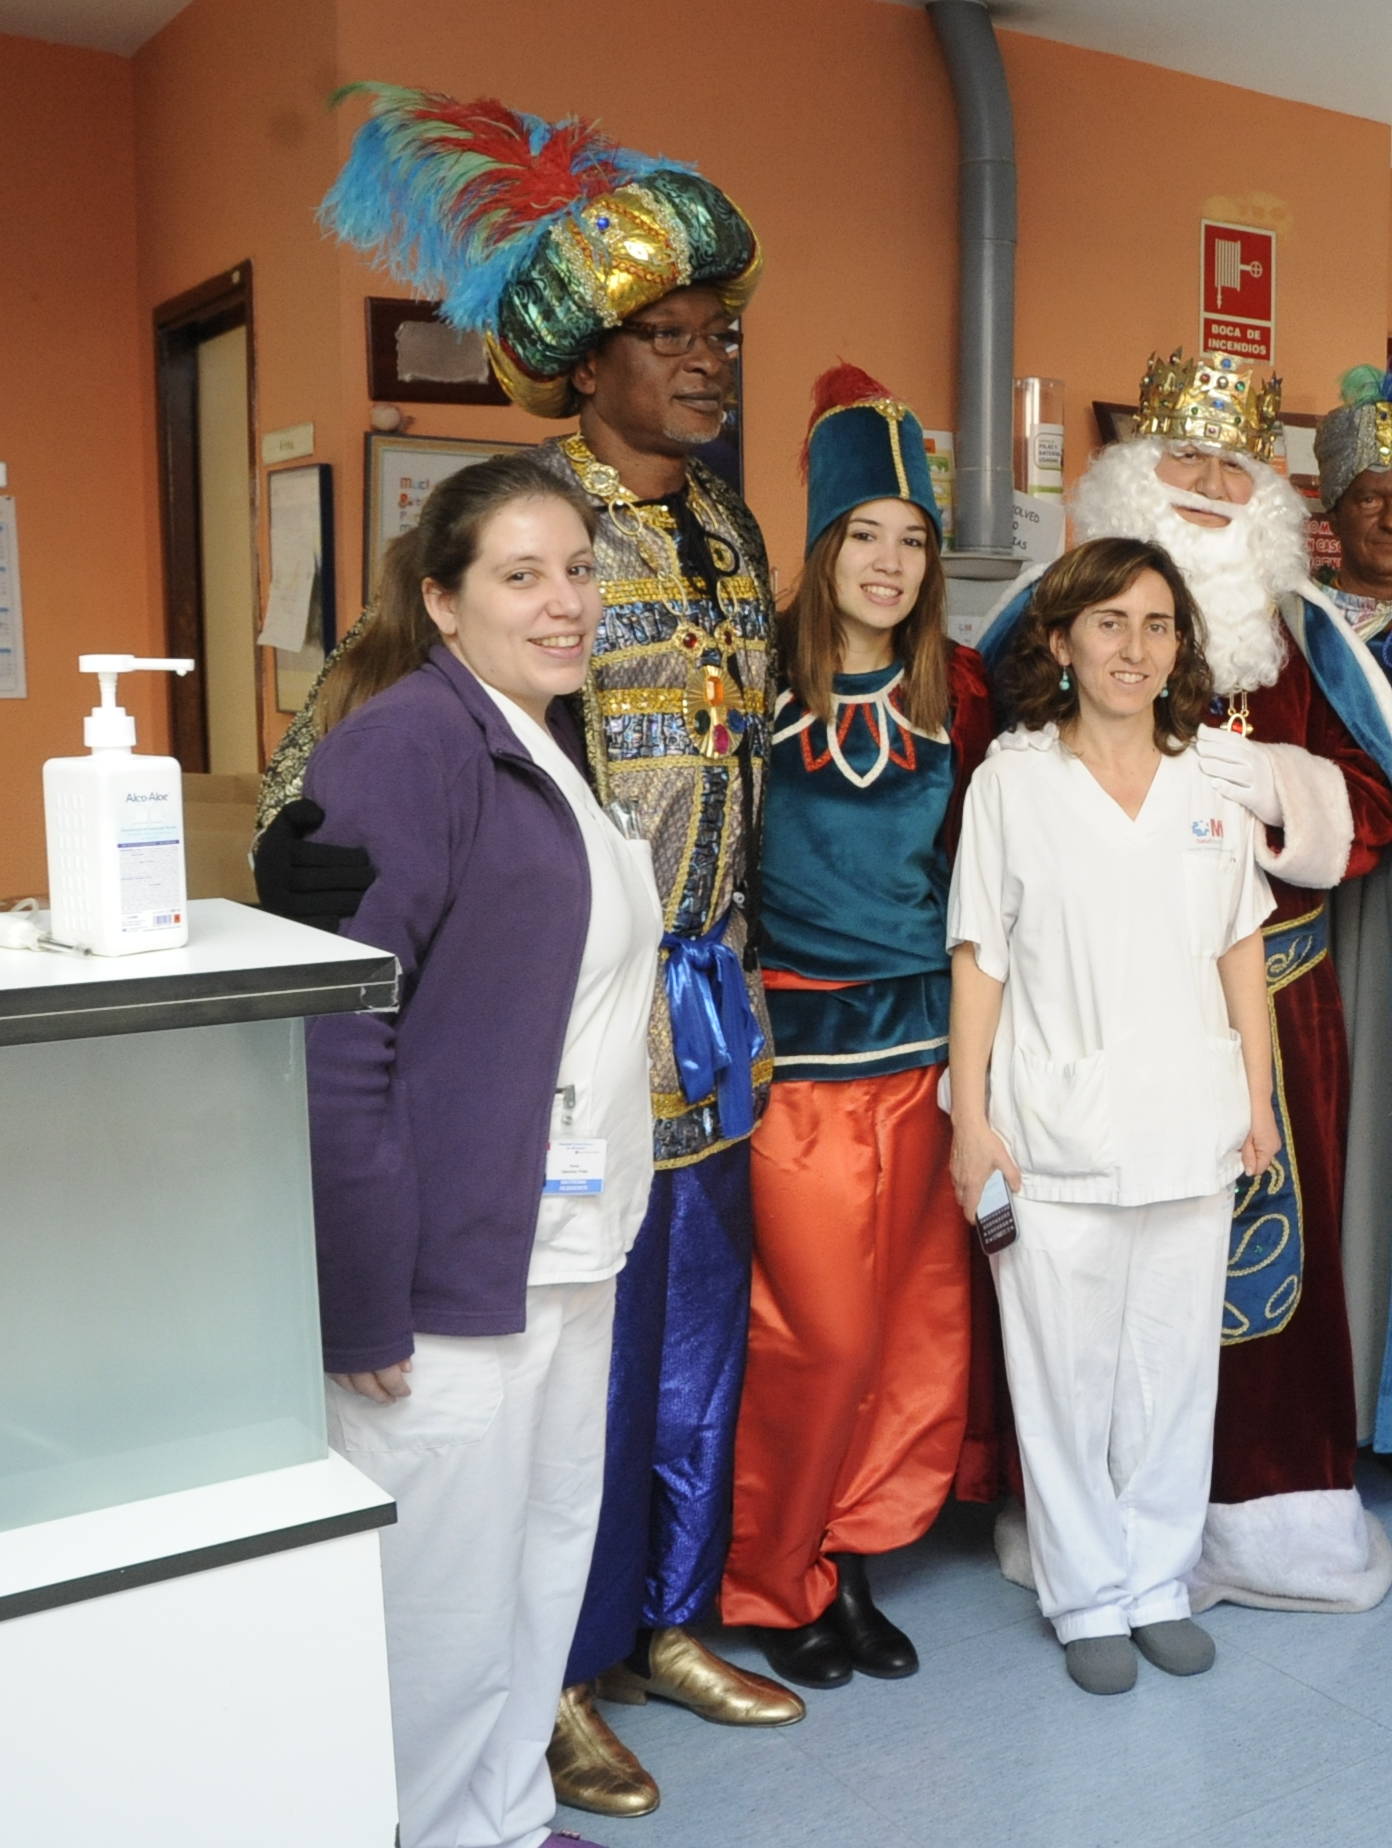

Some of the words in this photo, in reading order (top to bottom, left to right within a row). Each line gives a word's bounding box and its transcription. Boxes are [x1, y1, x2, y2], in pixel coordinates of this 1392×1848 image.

[1211, 323, 1241, 337] BOCA
[1247, 329, 1261, 340] DE
[1208, 338, 1266, 355] INCENDIOS
[1012, 504, 1039, 523] OLVED
